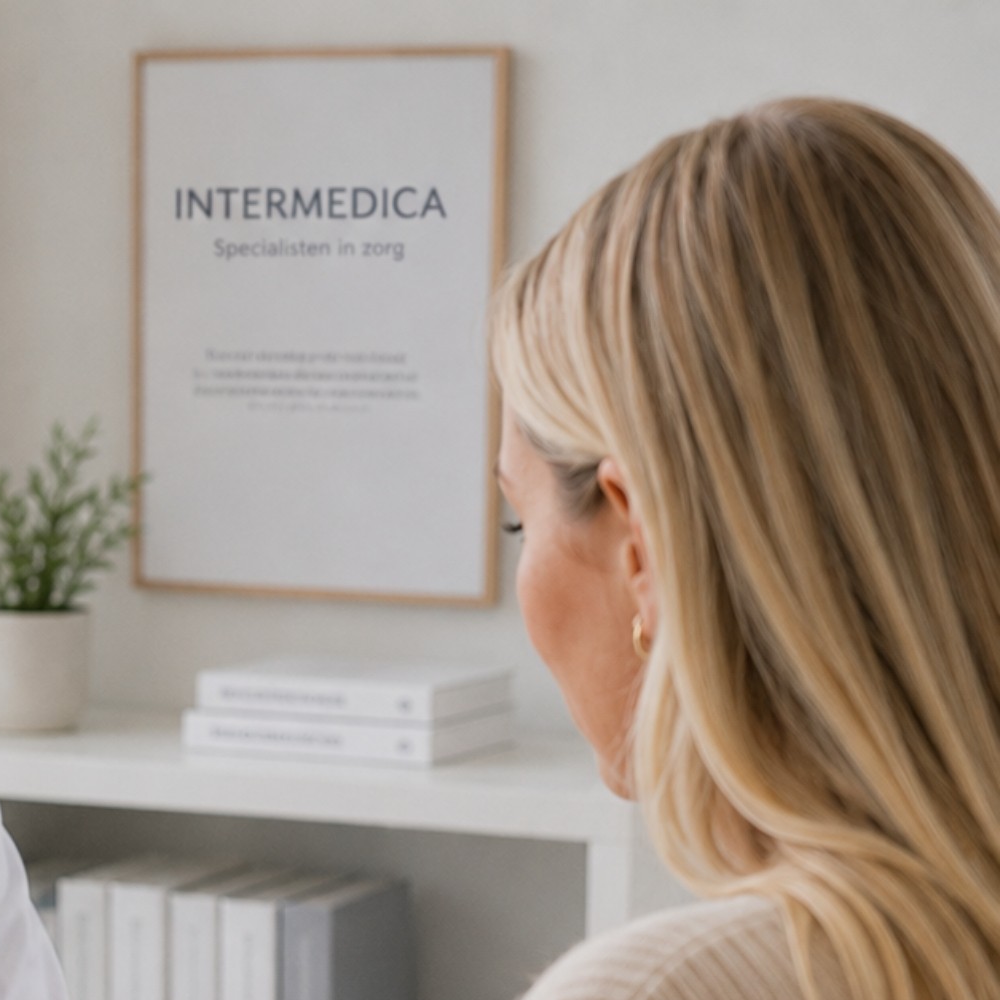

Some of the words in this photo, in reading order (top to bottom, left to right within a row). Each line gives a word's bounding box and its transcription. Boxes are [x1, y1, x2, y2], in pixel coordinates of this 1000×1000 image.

[174, 186, 447, 220] INTERMEDICA
[213, 238, 331, 260] Specialisten
[337, 238, 356, 256] in
[361, 243, 405, 262] zorg
